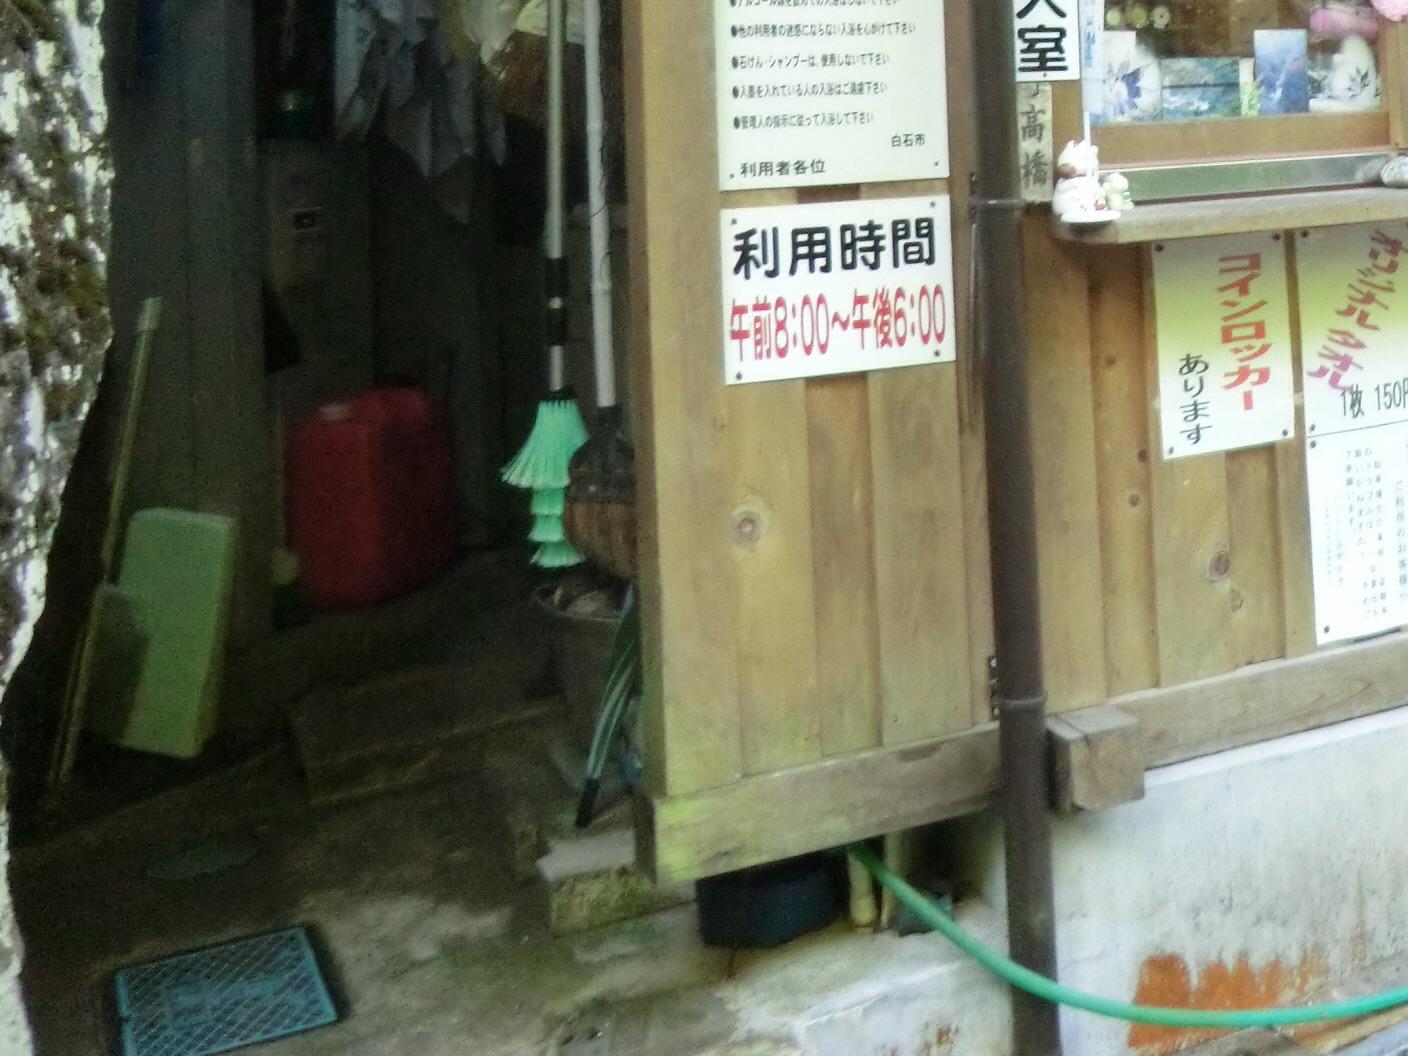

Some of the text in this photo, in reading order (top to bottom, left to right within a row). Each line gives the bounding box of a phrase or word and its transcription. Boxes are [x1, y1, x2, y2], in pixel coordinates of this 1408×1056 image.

[740, 158, 827, 178] 利用者各位
[891, 133, 926, 148] 白石市
[732, 216, 936, 281] 利用時間
[1217, 251, 1273, 412] コインロッカー
[1178, 352, 1213, 445] あります
